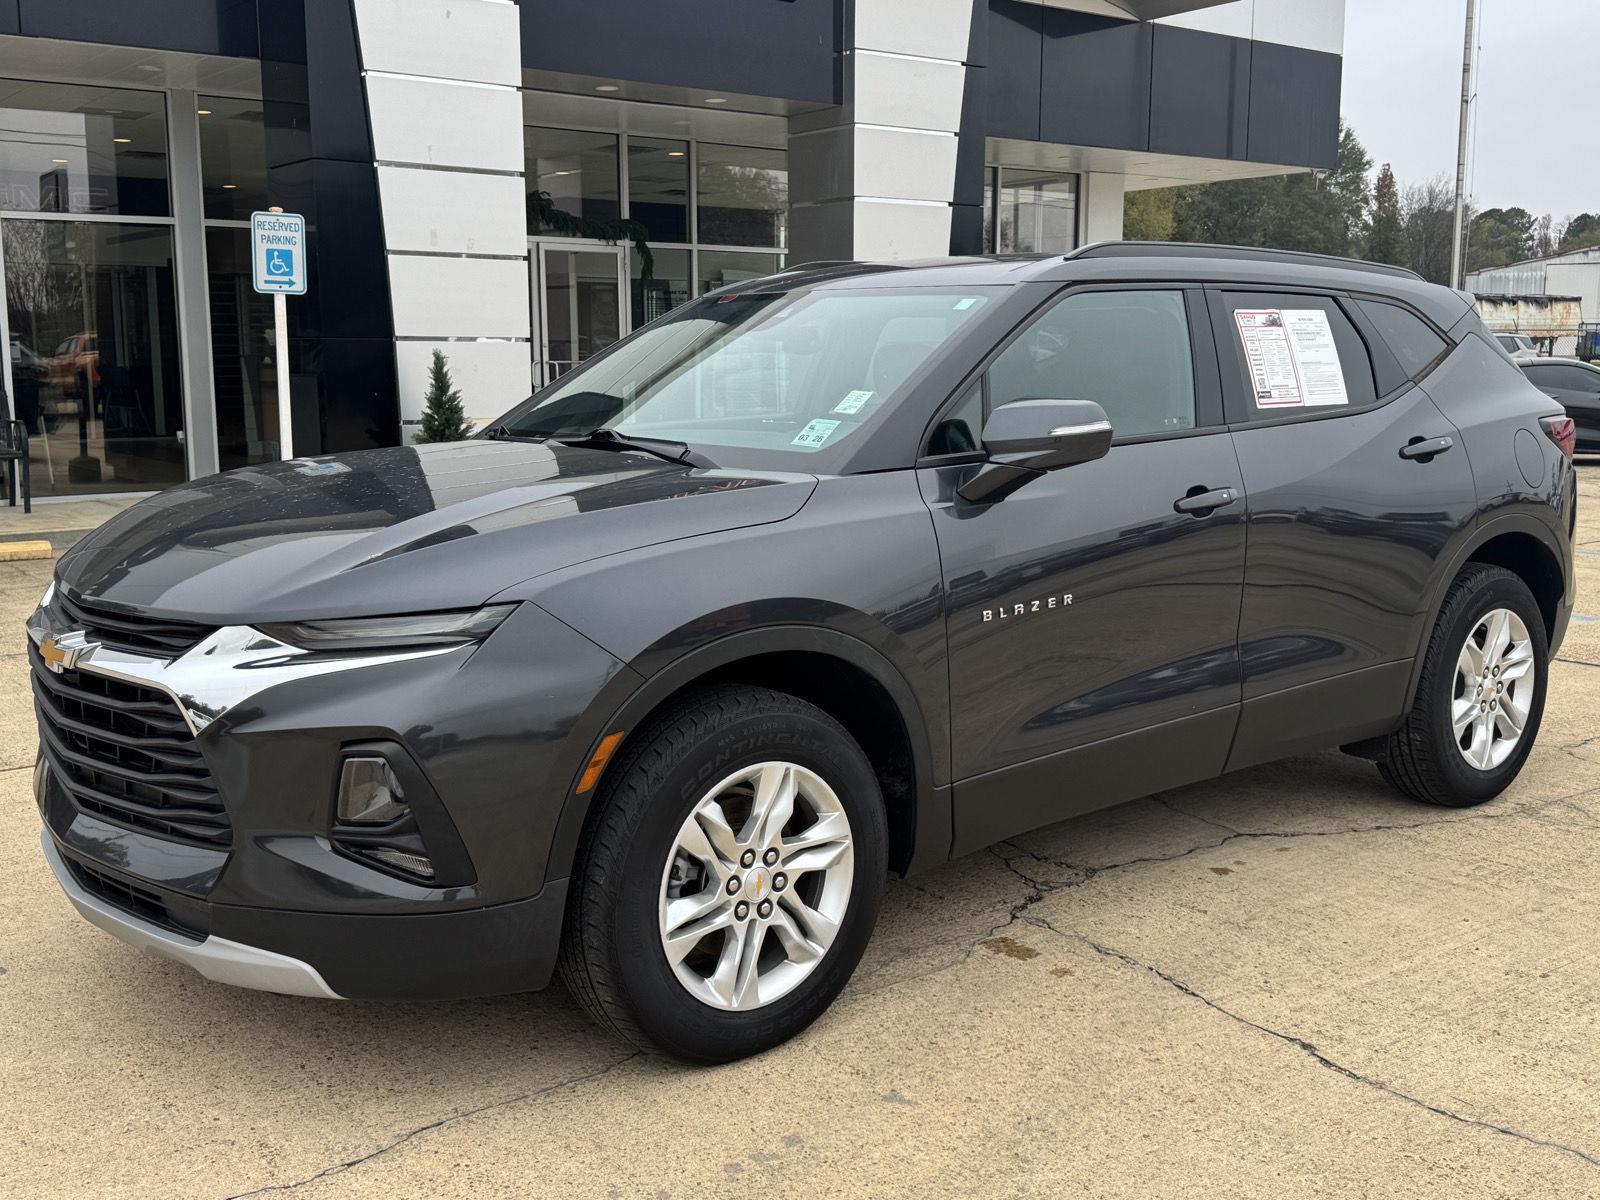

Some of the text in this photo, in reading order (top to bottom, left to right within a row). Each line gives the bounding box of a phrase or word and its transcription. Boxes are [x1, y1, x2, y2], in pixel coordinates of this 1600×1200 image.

[256, 220, 300, 233] RESERVED
[261, 234, 297, 246] PARKING
[797, 433, 810, 442] 03
[982, 594, 1073, 622] BLAZER
[680, 731, 842, 800] CONTINENTA
